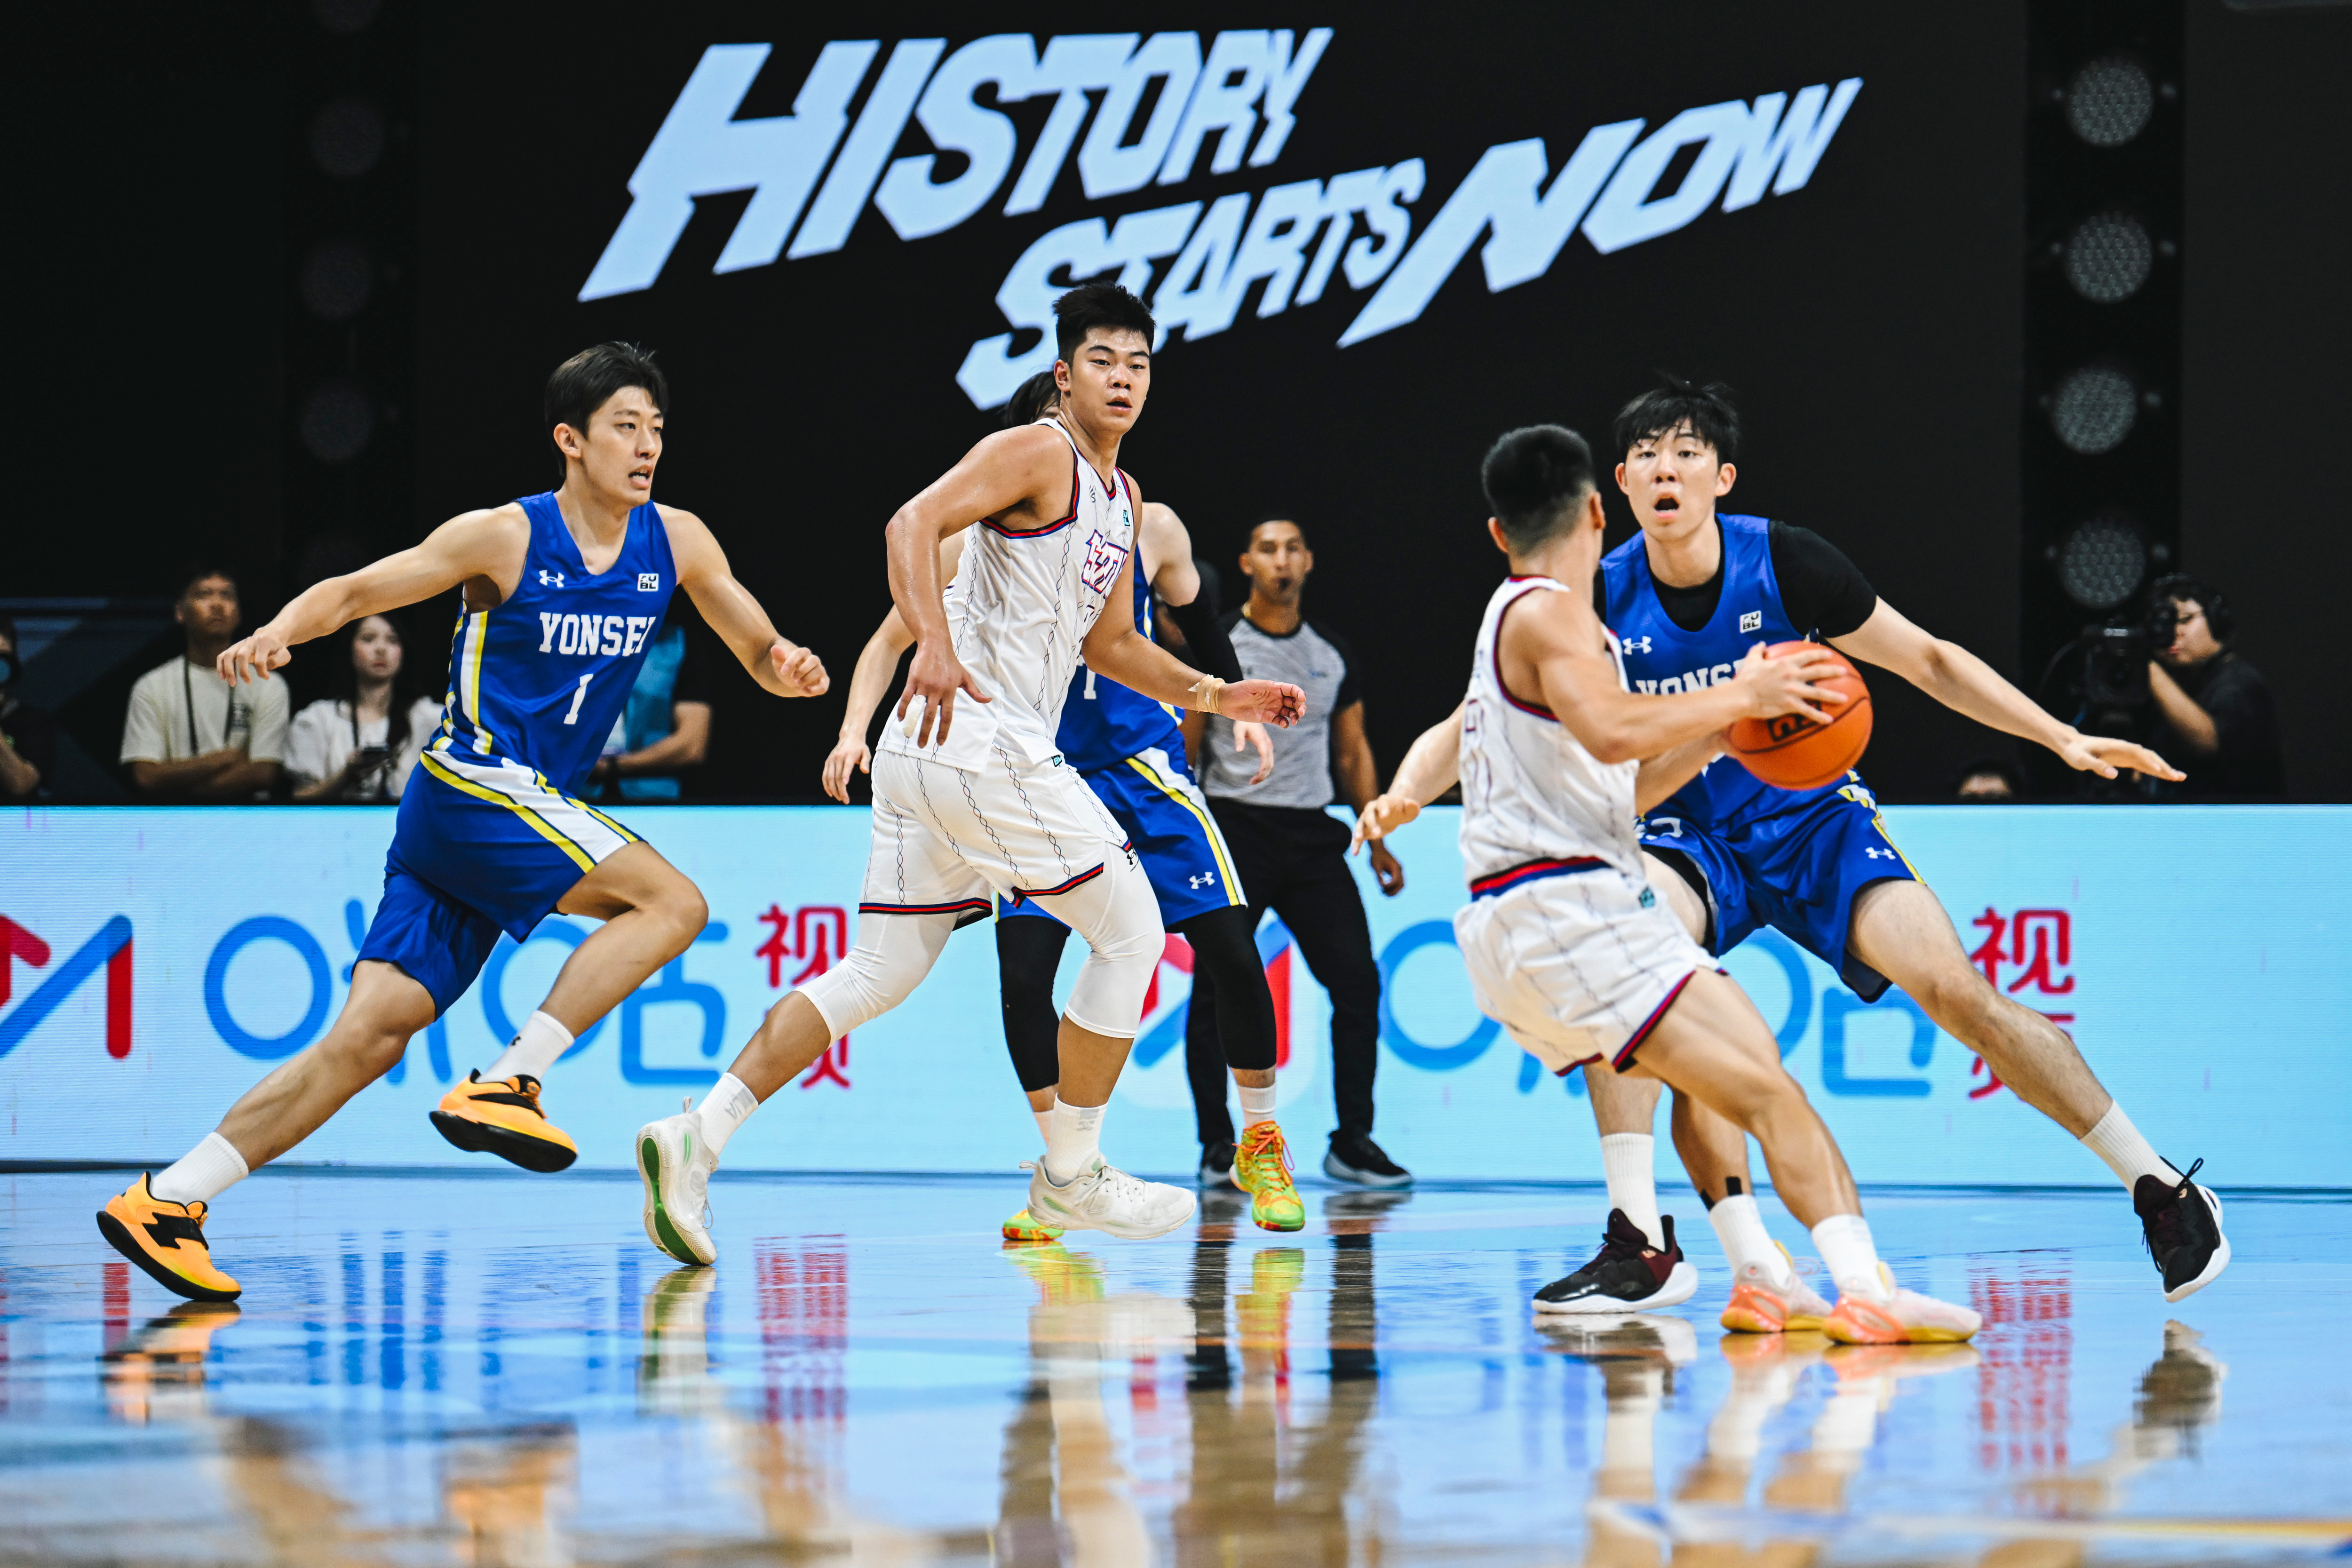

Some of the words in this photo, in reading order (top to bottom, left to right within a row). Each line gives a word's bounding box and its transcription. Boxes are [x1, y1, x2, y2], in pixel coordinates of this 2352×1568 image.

[578, 27, 1334, 302] HISTORY
[956, 158, 1426, 411] STARTS
[1335, 77, 1864, 349] NOW
[563, 673, 594, 725] 1
